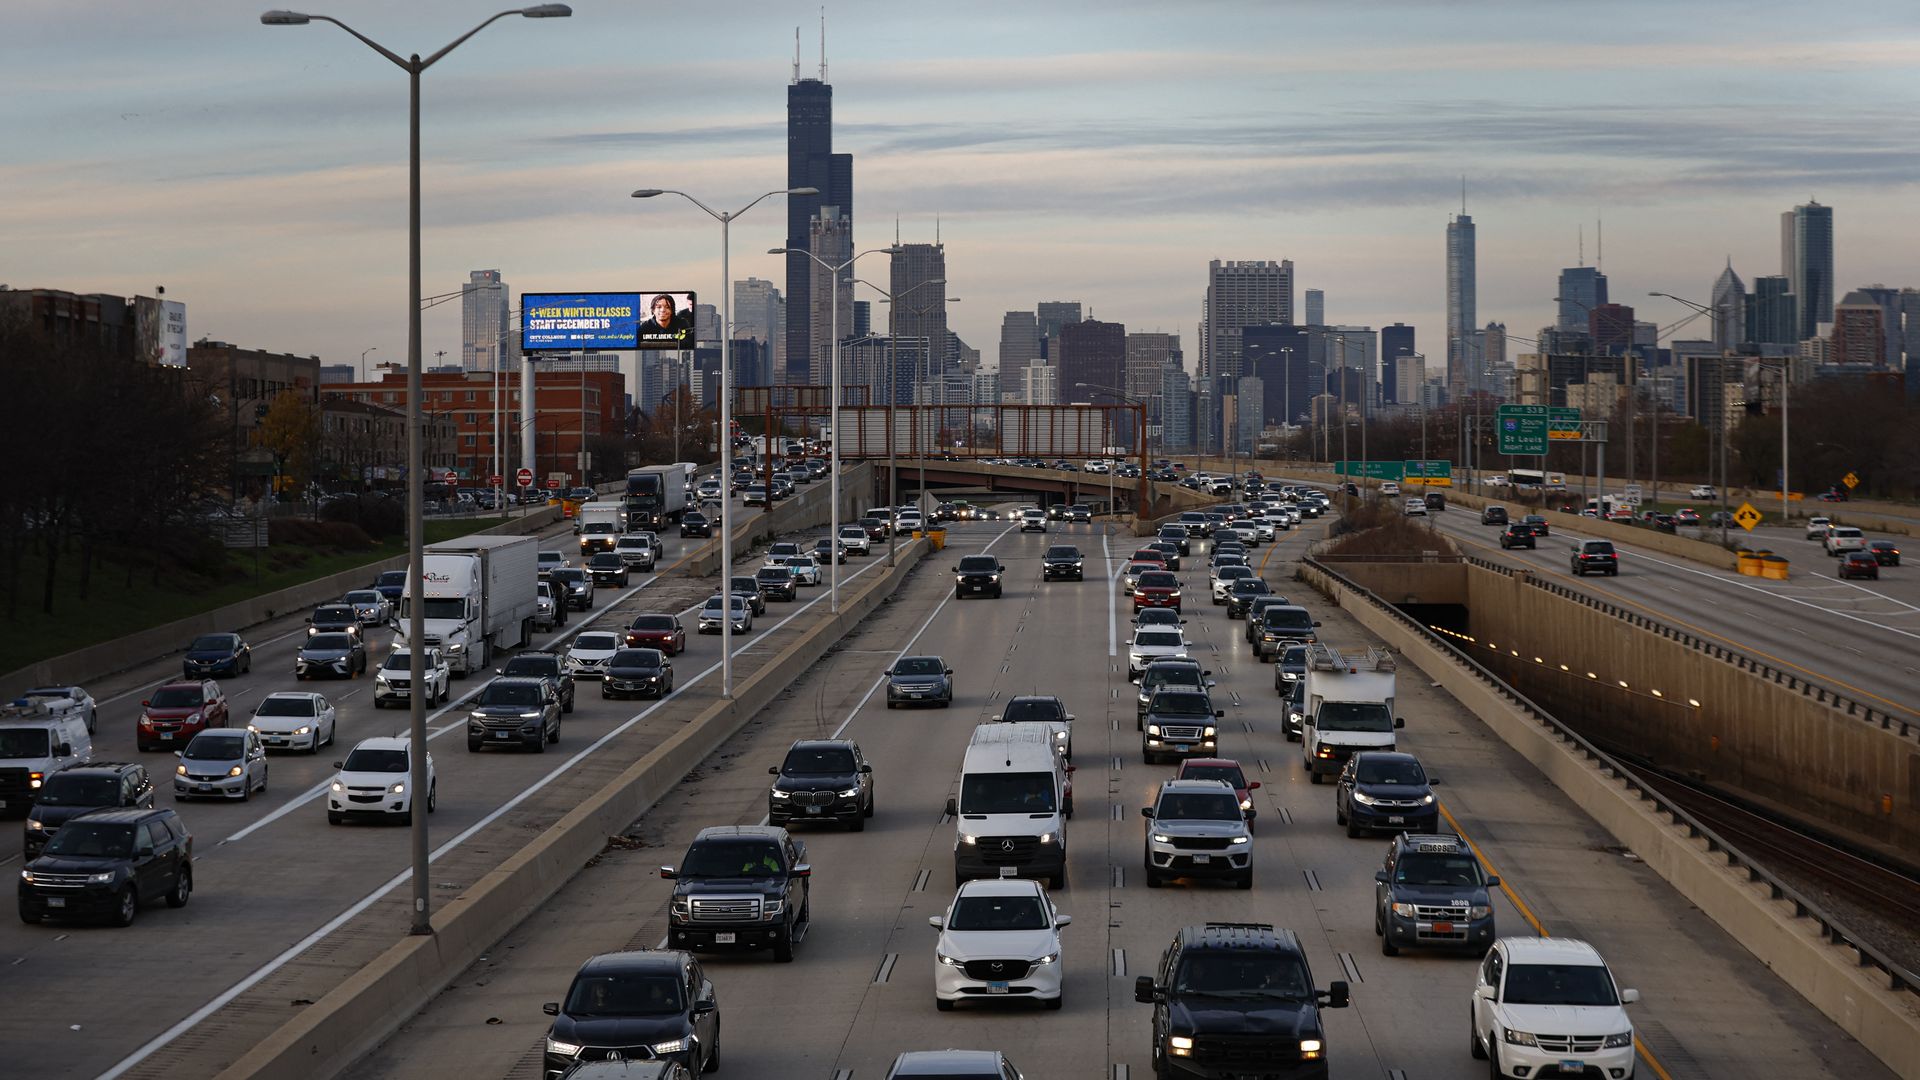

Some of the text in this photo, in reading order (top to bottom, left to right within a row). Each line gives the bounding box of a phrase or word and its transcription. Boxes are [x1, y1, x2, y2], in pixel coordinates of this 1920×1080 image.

[530, 307, 631, 318] 4-WEEK WINTER CLASSES
[530, 318, 610, 330] START DECEMBER 16
[1518, 435, 1542, 443] Louis
